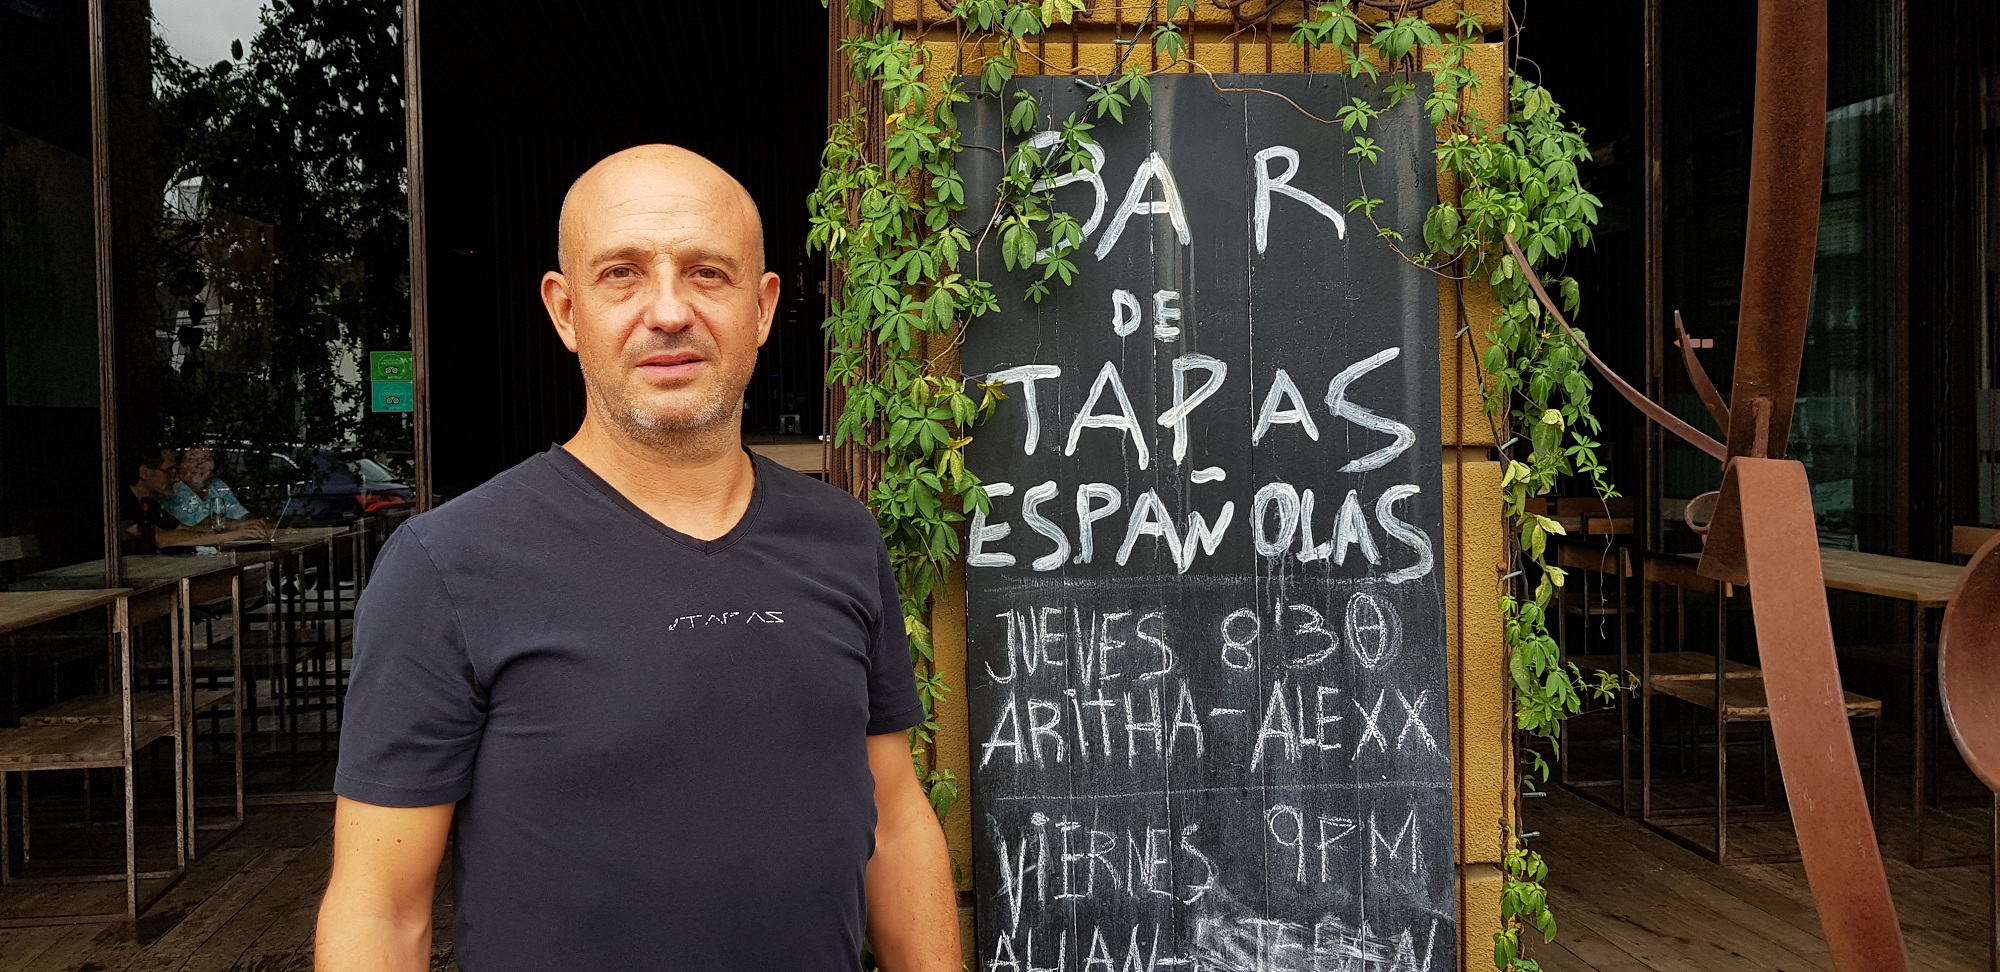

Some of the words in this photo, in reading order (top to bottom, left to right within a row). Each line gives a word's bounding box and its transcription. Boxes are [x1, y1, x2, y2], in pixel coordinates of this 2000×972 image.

[1018, 130, 1346, 262] BAR
[1112, 289, 1180, 341] DE
[987, 347, 1415, 473] TAPAS
[967, 466, 1434, 583] ESPAÑOLAS
[985, 605, 1174, 687] JUEVES
